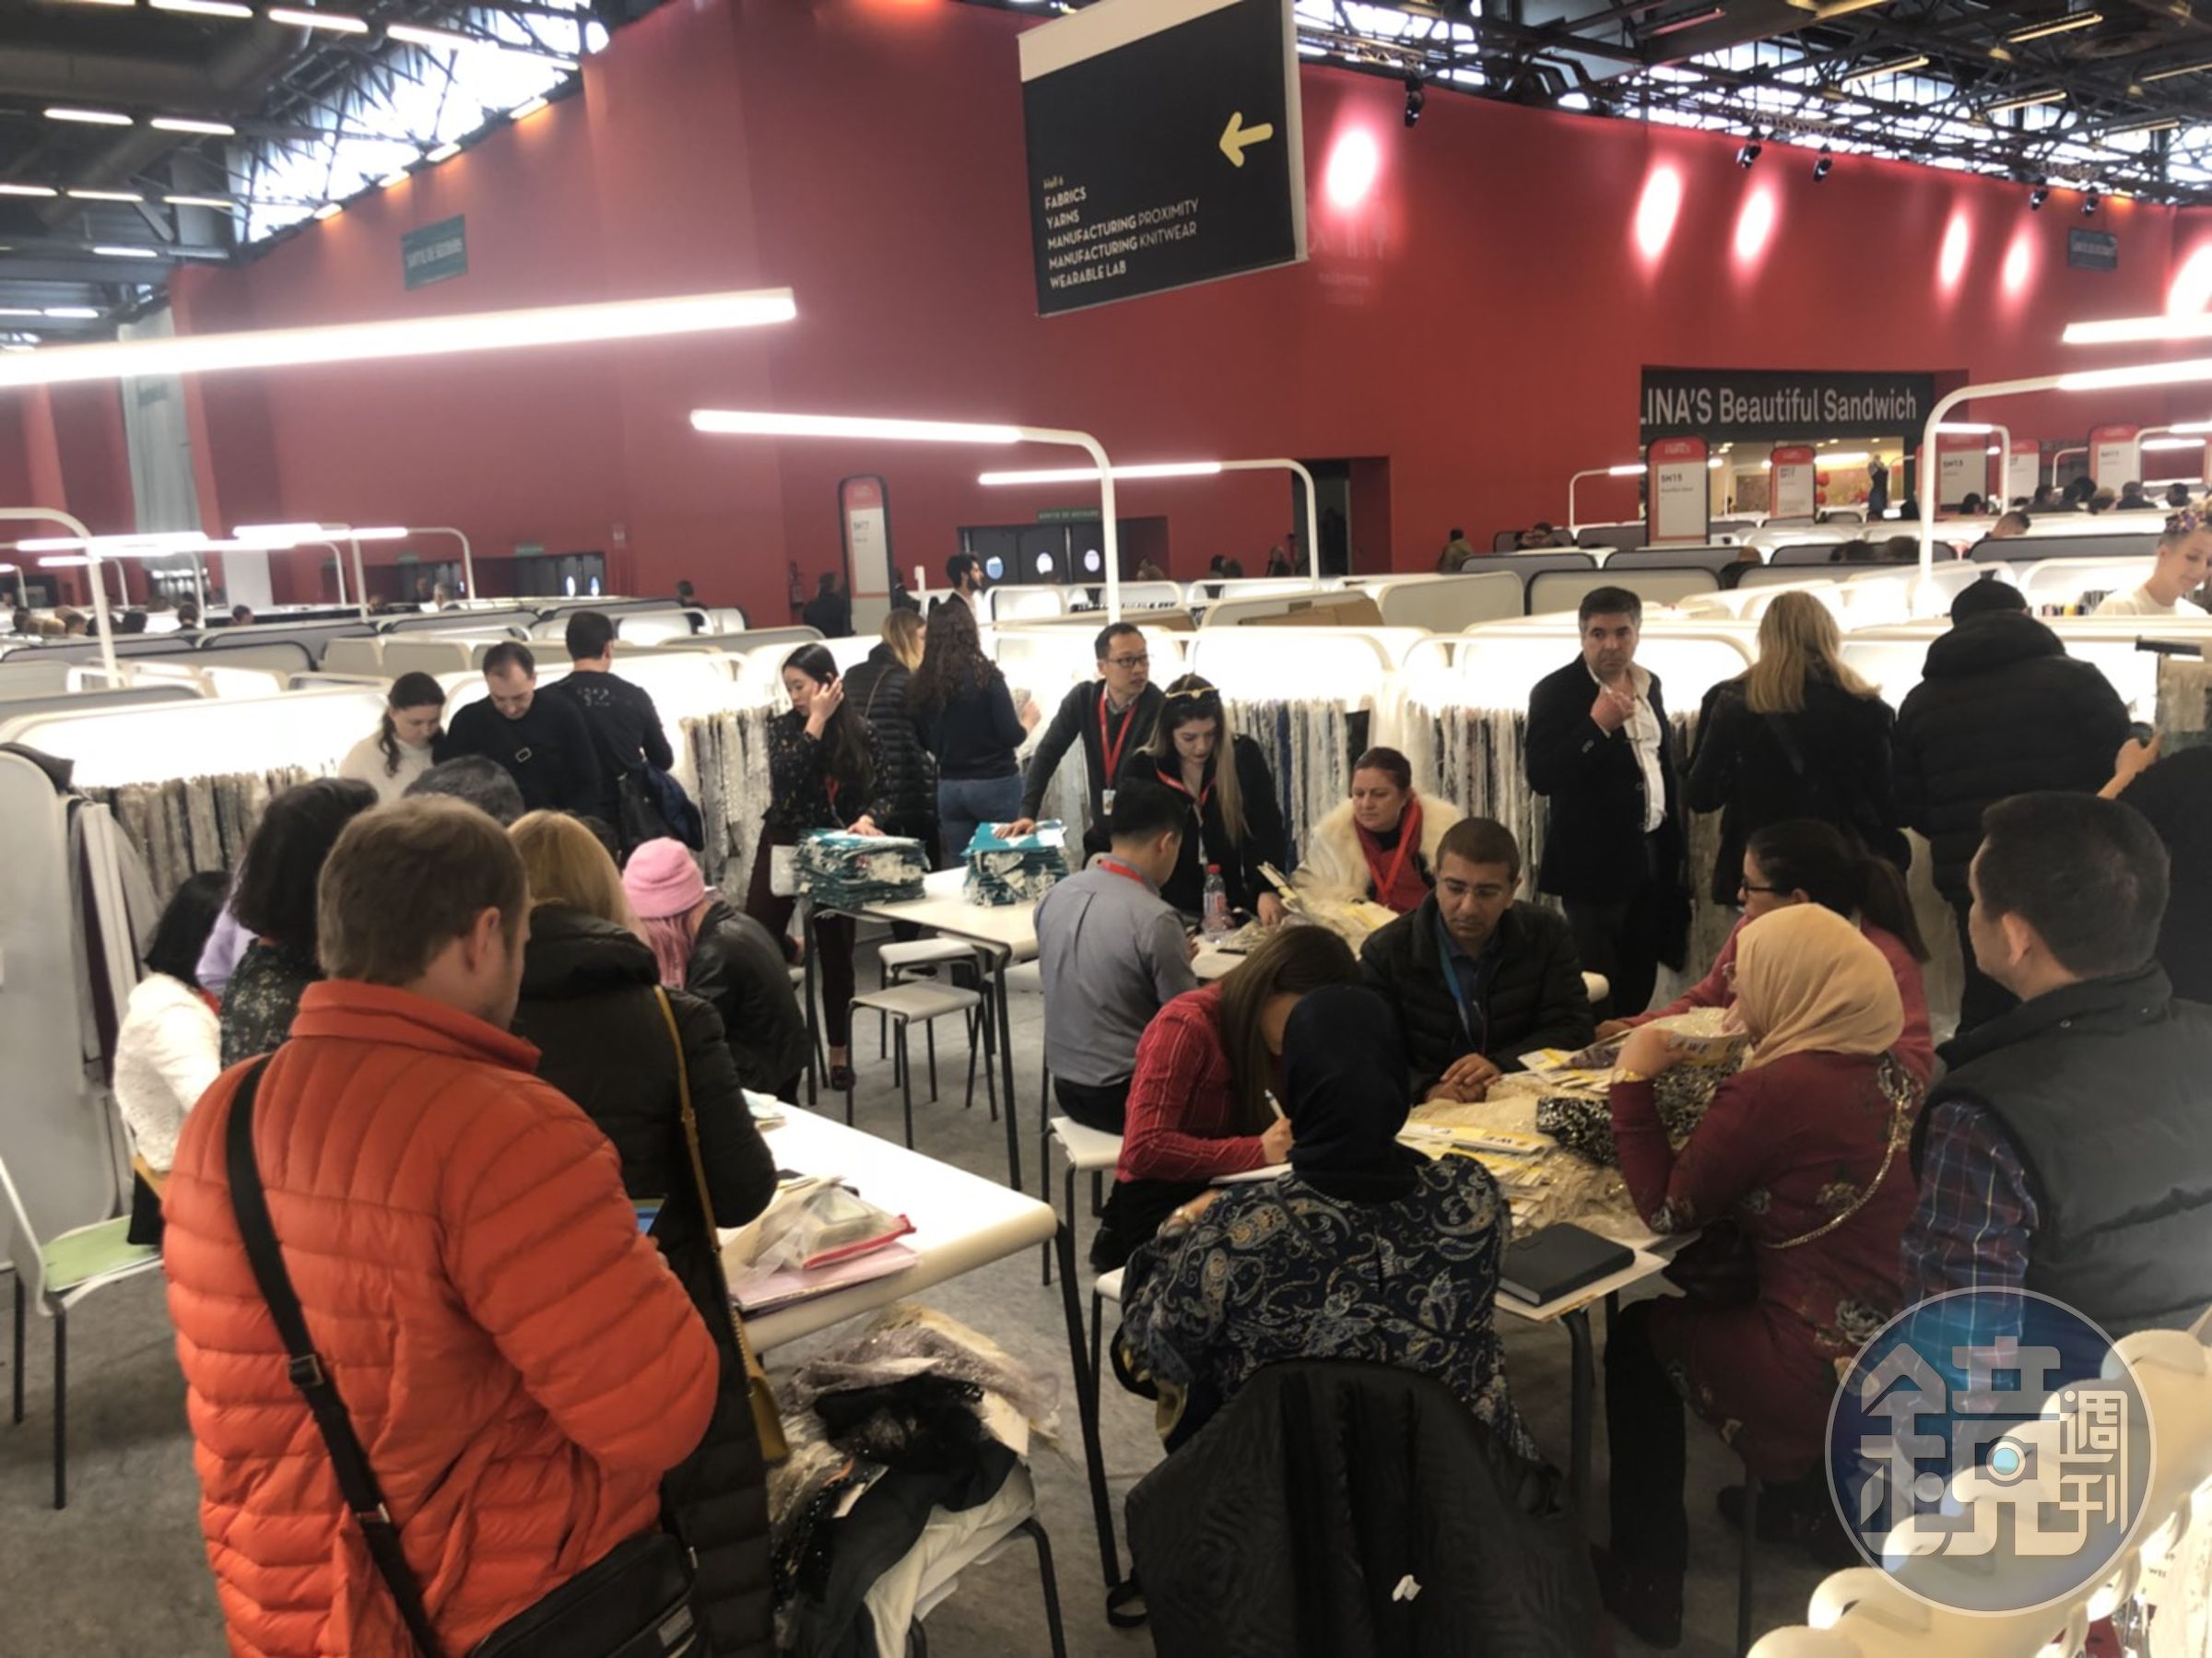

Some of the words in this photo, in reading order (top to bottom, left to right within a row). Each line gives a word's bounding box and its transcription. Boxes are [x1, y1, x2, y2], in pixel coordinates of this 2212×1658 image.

[1045, 187, 1087, 210] FABRICS
[1046, 209, 1080, 229] YARNS
[1047, 215, 1136, 251] MANUFACTURING
[1137, 197, 1199, 227] PROXIMITY
[1049, 236, 1138, 270] MANUFACTURING
[1139, 221, 1197, 249] KNITWEAR
[1050, 265, 1104, 289] WEARABLE
[1106, 260, 1126, 279] LAB
[1720, 388, 1818, 424] Beautiful
[1824, 387, 1917, 422] Sandwich
